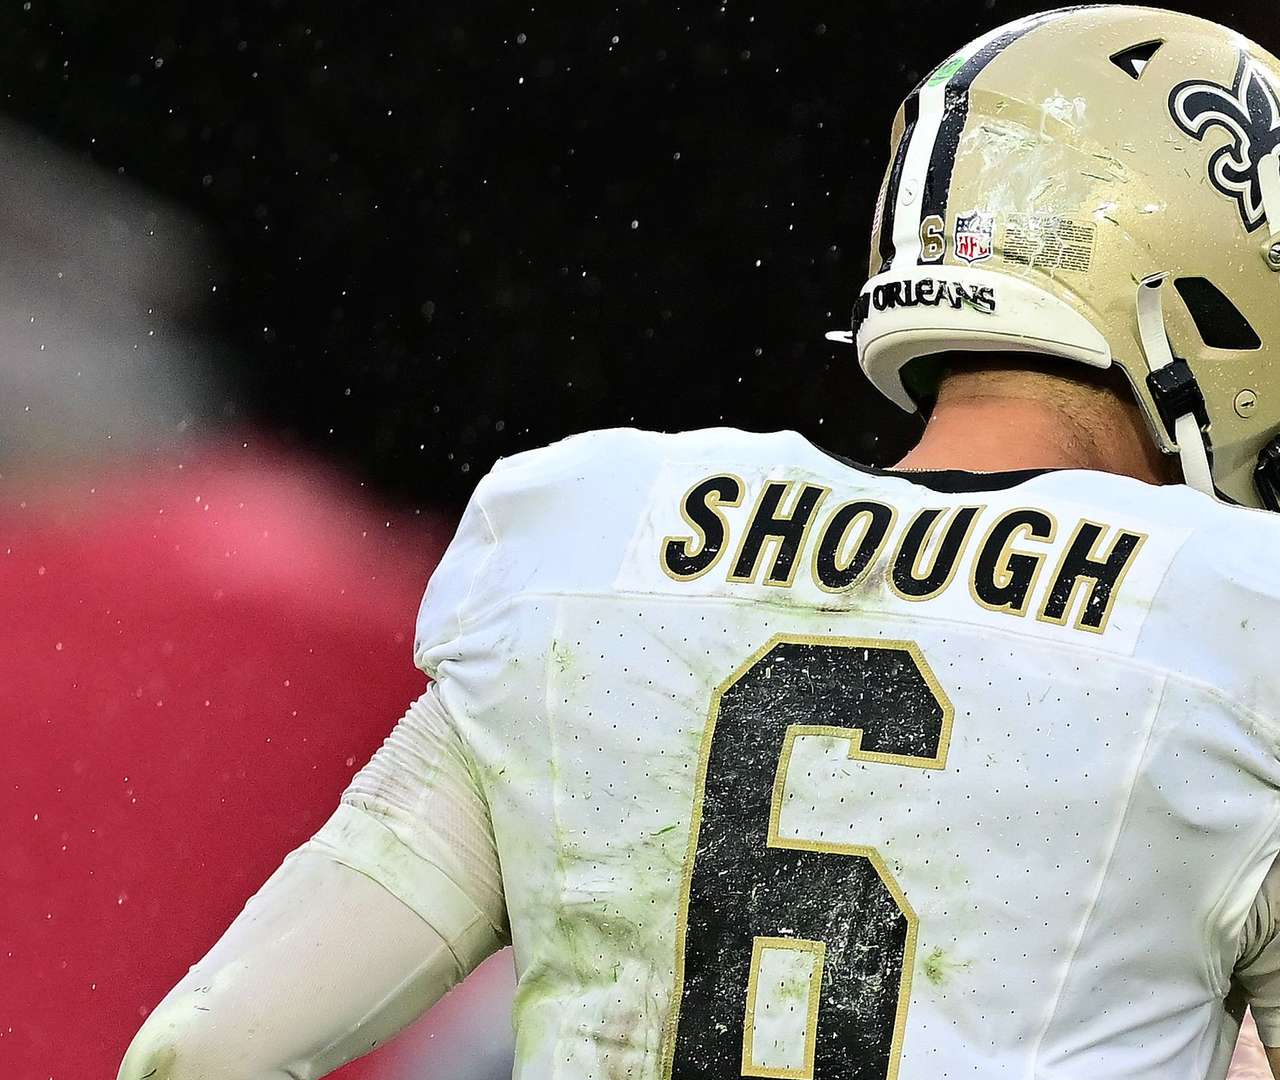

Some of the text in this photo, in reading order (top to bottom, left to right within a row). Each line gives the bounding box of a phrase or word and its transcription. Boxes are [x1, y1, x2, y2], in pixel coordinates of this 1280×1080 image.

[919, 215, 945, 262] 6
[873, 277, 996, 314] ORLEANS
[660, 473, 1148, 634] SHOUGH
